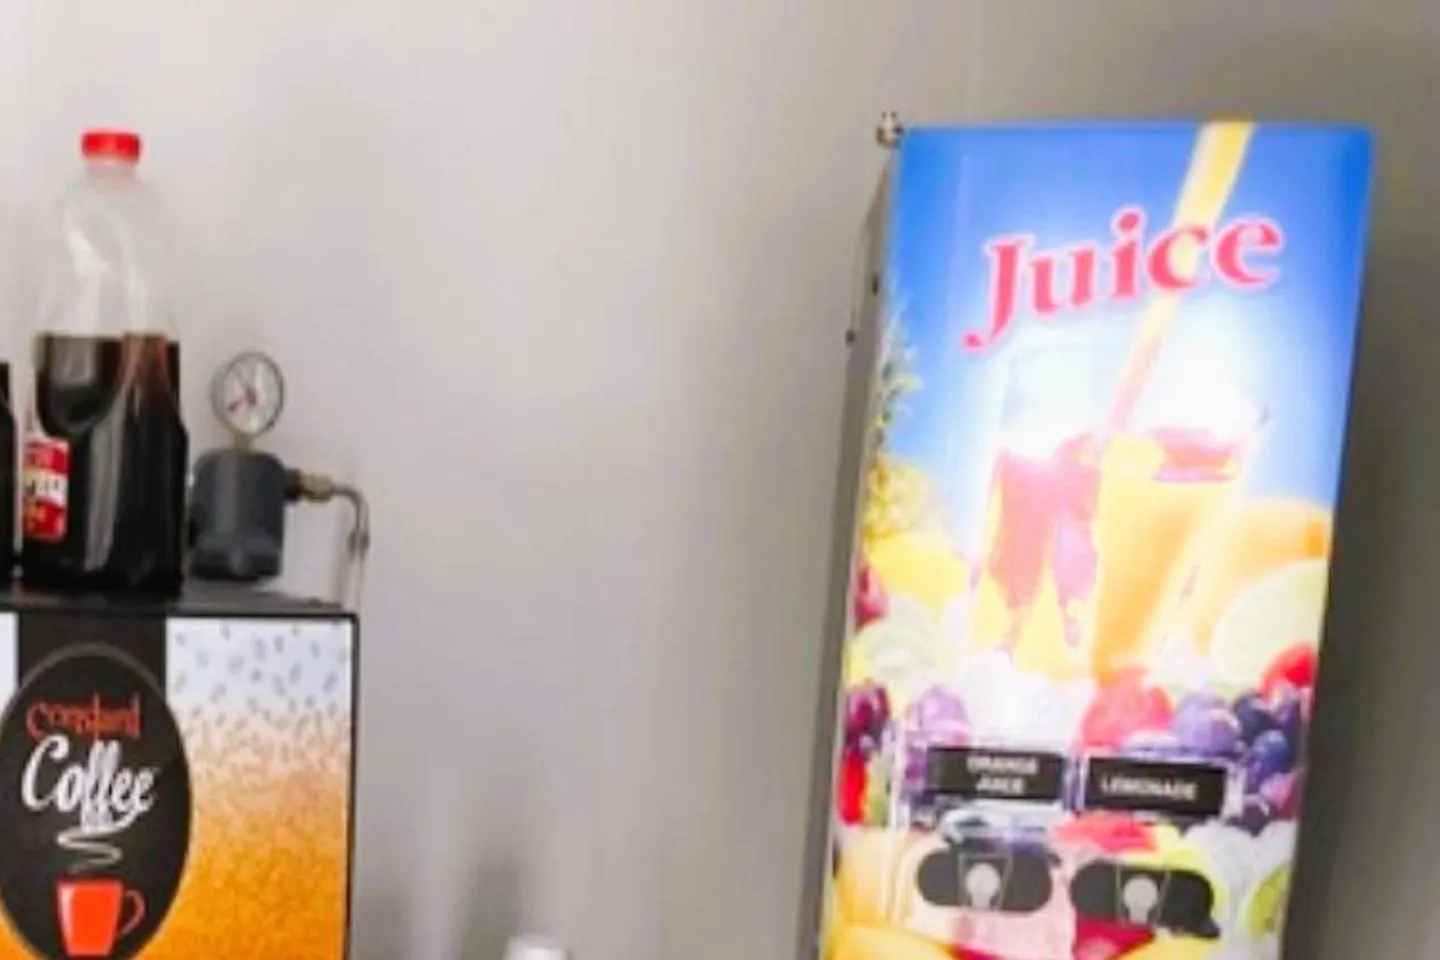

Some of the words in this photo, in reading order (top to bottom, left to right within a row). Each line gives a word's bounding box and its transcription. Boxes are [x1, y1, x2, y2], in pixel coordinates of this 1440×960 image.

[963, 208, 1283, 351] Juice
[20, 734, 158, 834] Coffee
[1100, 773, 1198, 801] LEMONADE
